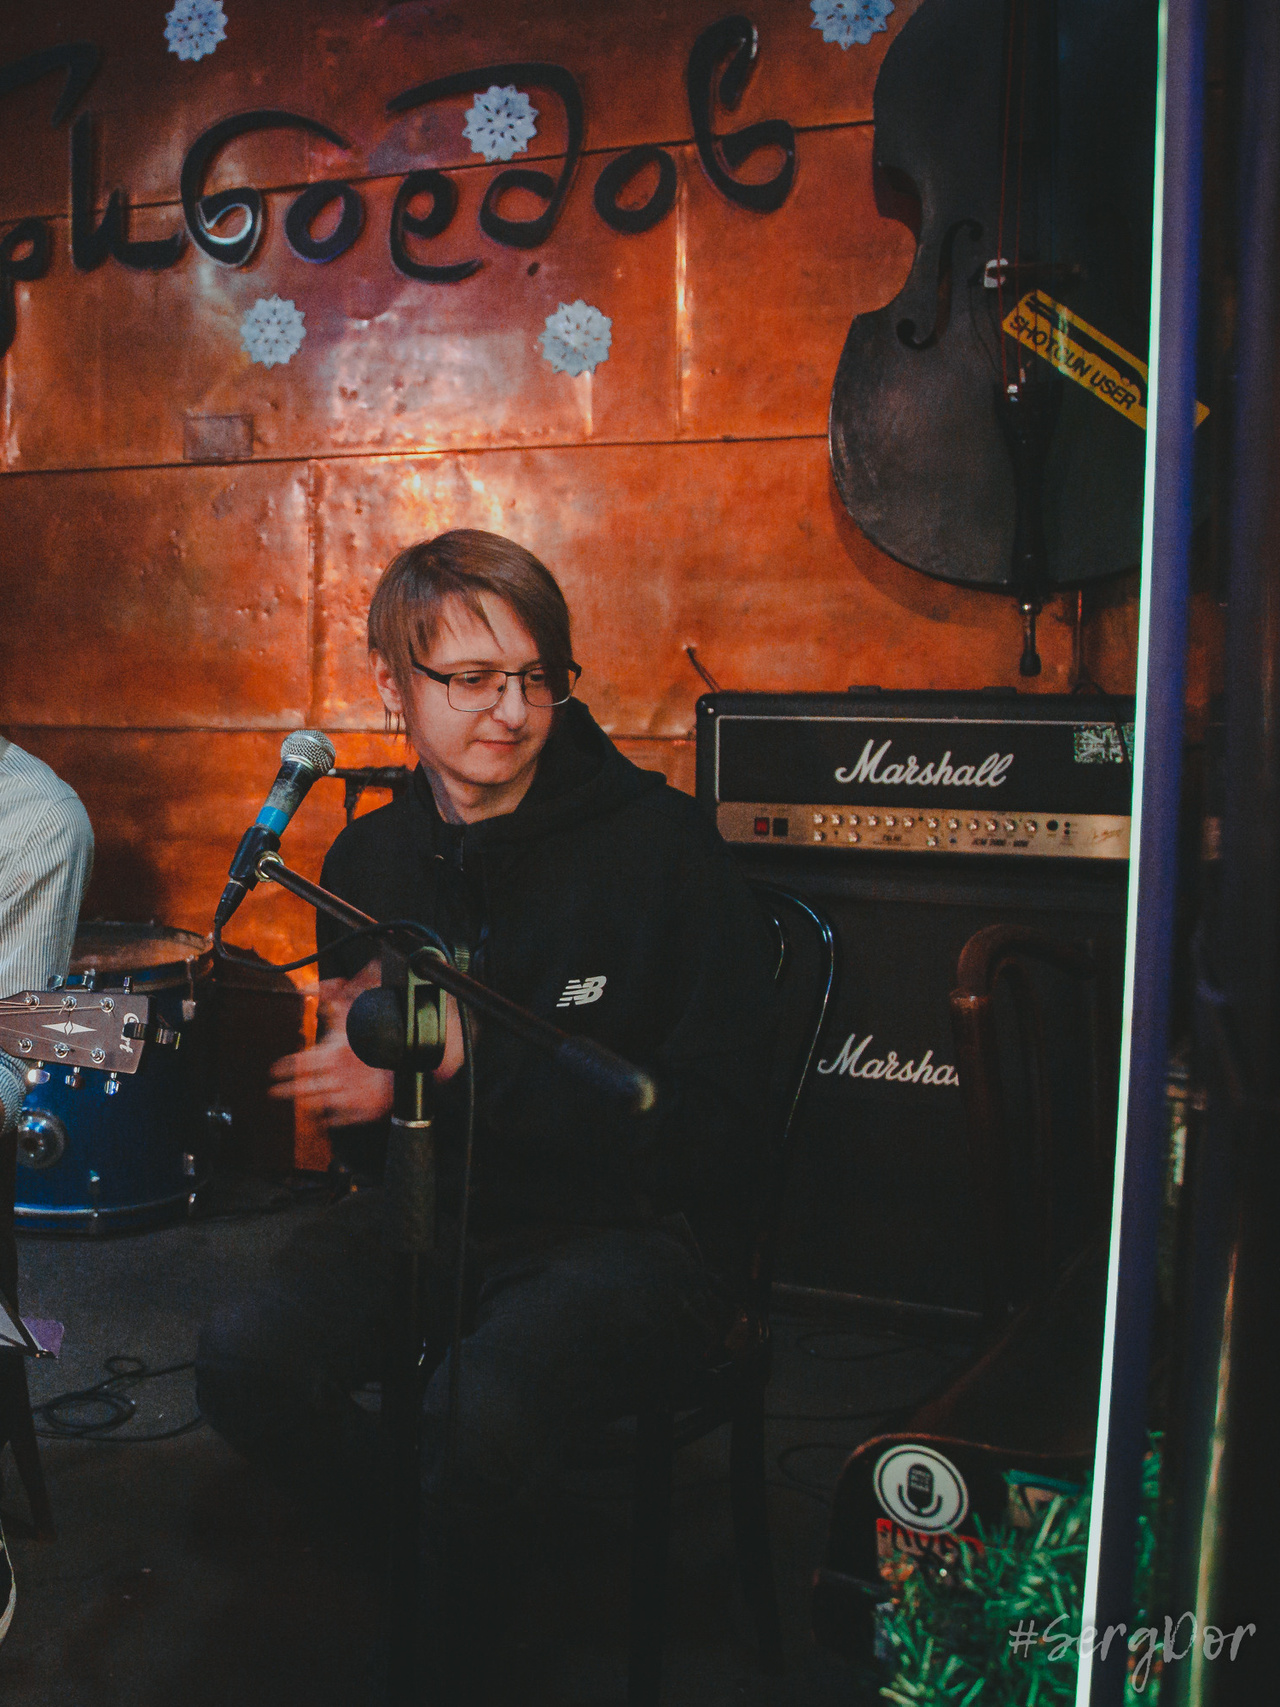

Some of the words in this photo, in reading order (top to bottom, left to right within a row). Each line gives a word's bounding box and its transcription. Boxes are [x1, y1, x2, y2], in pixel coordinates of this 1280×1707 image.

[1009, 315, 1092, 378] SHOTGUN
[1089, 371, 1137, 410] USER
[834, 739, 1014, 787] Marshall
[119, 1012, 140, 1054] Crt
[817, 1033, 959, 1086] Marsha
